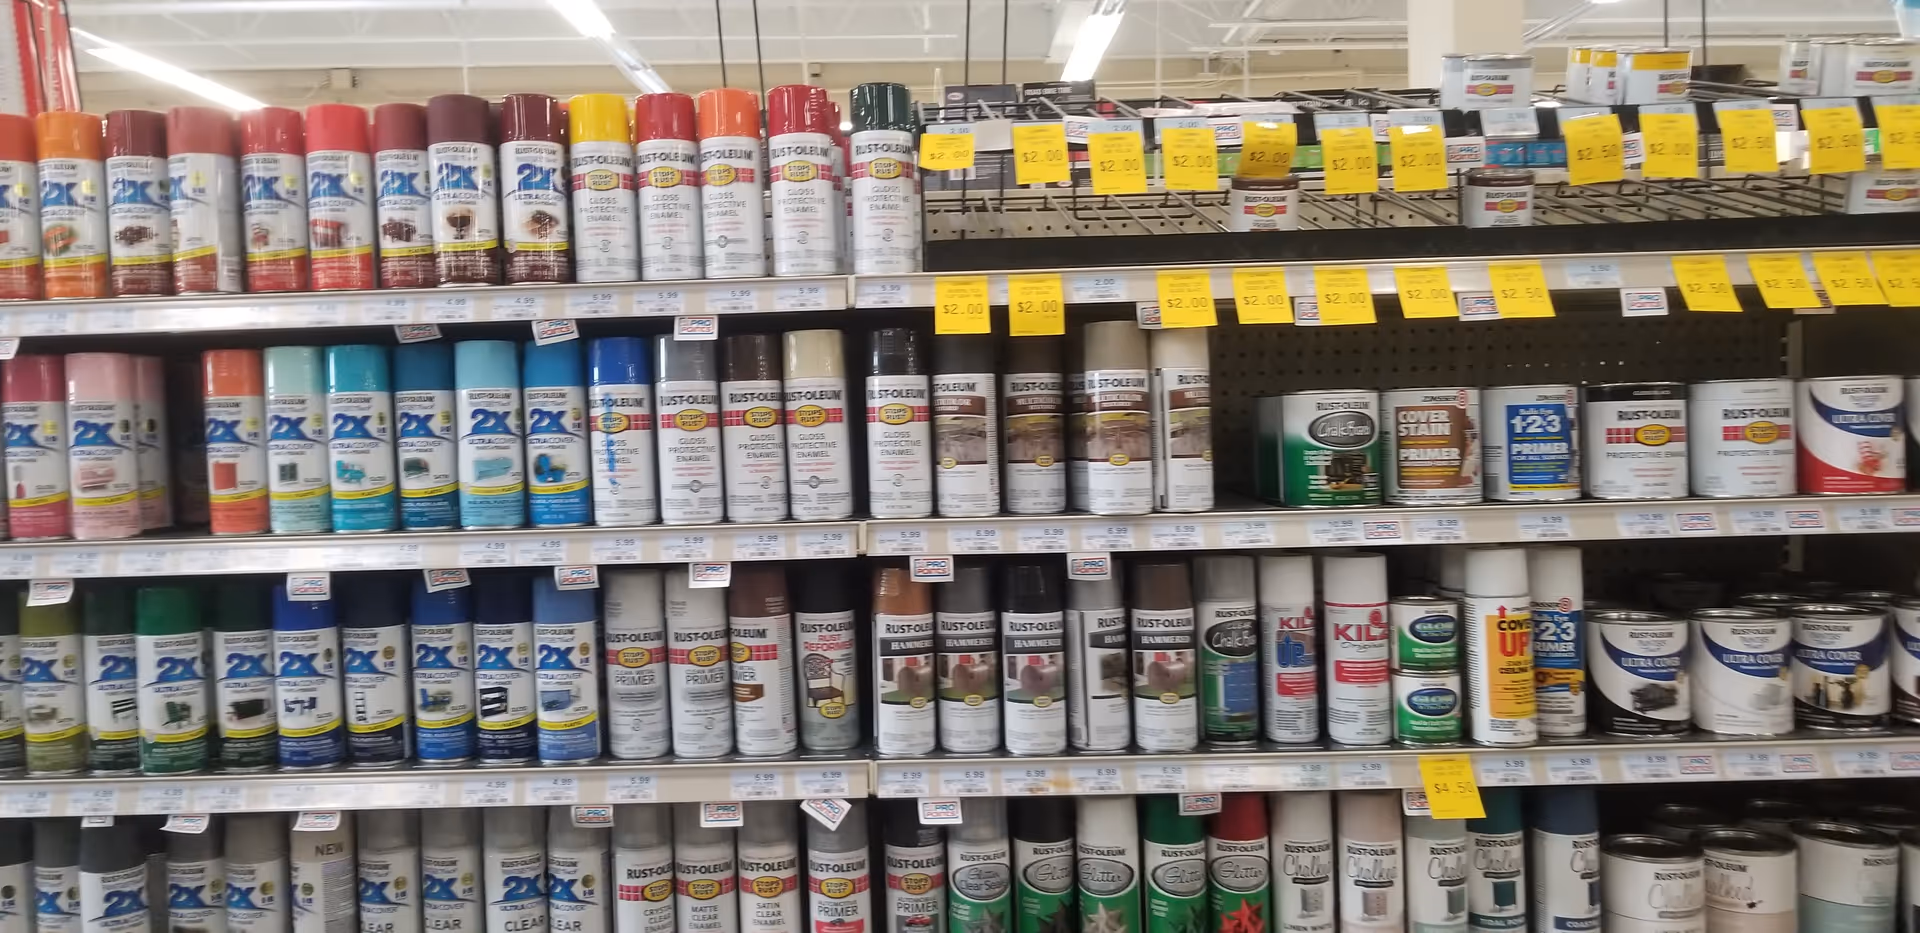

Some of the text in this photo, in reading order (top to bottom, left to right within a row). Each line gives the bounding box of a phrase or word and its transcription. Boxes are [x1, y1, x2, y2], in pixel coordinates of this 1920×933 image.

[1023, 150, 1063, 163] $2.00
[1172, 155, 1212, 168] $2.00
[1249, 151, 1289, 164] $2.00
[1400, 154, 1440, 167] $2.00
[1100, 158, 1140, 172] $2.00
[1332, 157, 1372, 171] $2.00
[1687, 282, 1728, 294] $2.50
[658, 291, 678, 299] 5.99
[1324, 292, 1365, 304] $2.00
[1407, 288, 1448, 300] $2.00
[1501, 288, 1544, 300] $2.50
[515, 296, 535, 304] 4.99
[1168, 297, 1207, 309] $2.00
[1244, 295, 1284, 306] $2.00
[943, 303, 984, 315] $2.00
[1017, 300, 1058, 313] $2.00
[471, 408, 511, 436] 2X
[529, 408, 567, 435] 2X
[1398, 411, 1449, 423] COVER
[207, 418, 241, 443] 2X
[270, 415, 306, 441] 2X
[332, 413, 372, 439] 2X
[399, 412, 437, 438] 2X
[1399, 423, 1451, 436] STAIN
[73, 420, 116, 447] 2X
[749, 434, 776, 442] GLOSS
[678, 437, 706, 445] GLOSS
[1399, 448, 1460, 460] PRIMER
[1511, 443, 1568, 454] PRIMER
[676, 454, 710, 463] ENAMEL
[747, 451, 779, 459] ENAMEL
[976, 529, 995, 537] 6.99
[1107, 526, 1127, 534] 6.99
[684, 536, 704, 544] 5.99
[823, 533, 842, 541] 5.99
[541, 540, 561, 548] 4.99
[926, 560, 946, 568] PRO
[1084, 559, 1103, 568] PRO
[917, 567, 947, 575] POINTS
[1629, 630, 1674, 639] RUST-OLEUM
[1731, 627, 1776, 635] RUST-OLEUM
[818, 634, 841, 642] RUST
[946, 637, 993, 646] HAMMERED
[1014, 638, 1061, 648] HAMMERED
[1141, 635, 1190, 644] HAMMERED
[803, 641, 852, 651] REFORMER
[1500, 631, 1529, 657] UP
[345, 647, 379, 673] 2X
[416, 643, 455, 668] 2X
[477, 644, 514, 669] 2X
[538, 643, 576, 669] 2X
[1723, 654, 1784, 663] ULTRA COVER
[226, 653, 268, 678] 2X
[279, 651, 319, 677] 2X
[1622, 658, 1652, 667] ULTRA
[22, 656, 58, 682] 2X
[156, 656, 198, 682] 2X
[615, 674, 655, 685] PRIMER
[686, 672, 725, 685] PRIMER
[1362, 763, 1381, 771] 5.99
[631, 776, 651, 784] 5.99
[1434, 783, 1473, 794] $4.50
[1193, 795, 1216, 804] PRO
[586, 809, 607, 817] PRO
[717, 804, 737, 812] PRO
[927, 810, 956, 818] POINTS
[315, 841, 343, 856] NEW
[1217, 843, 1264, 853] RUST-OLEUM
[1347, 845, 1397, 856] RUST-OLEUM
[960, 851, 1005, 862] RUST-OLEUM
[810, 860, 866, 873] RUST-OLEUM
[1219, 861, 1262, 879] Glitter
[503, 874, 542, 901] 2X
[756, 880, 780, 888] STOPS
[691, 905, 718, 913] MATTE
[756, 902, 780, 910] SATIN
[818, 906, 859, 917] PRIMER
[897, 901, 938, 913] PRIMER
[692, 913, 718, 922] CLEAR
[756, 910, 782, 918] CLEAR
[505, 915, 544, 932] CLEAR
[689, 921, 722, 930] ENAMEL
[753, 918, 786, 926] ENAMEL
